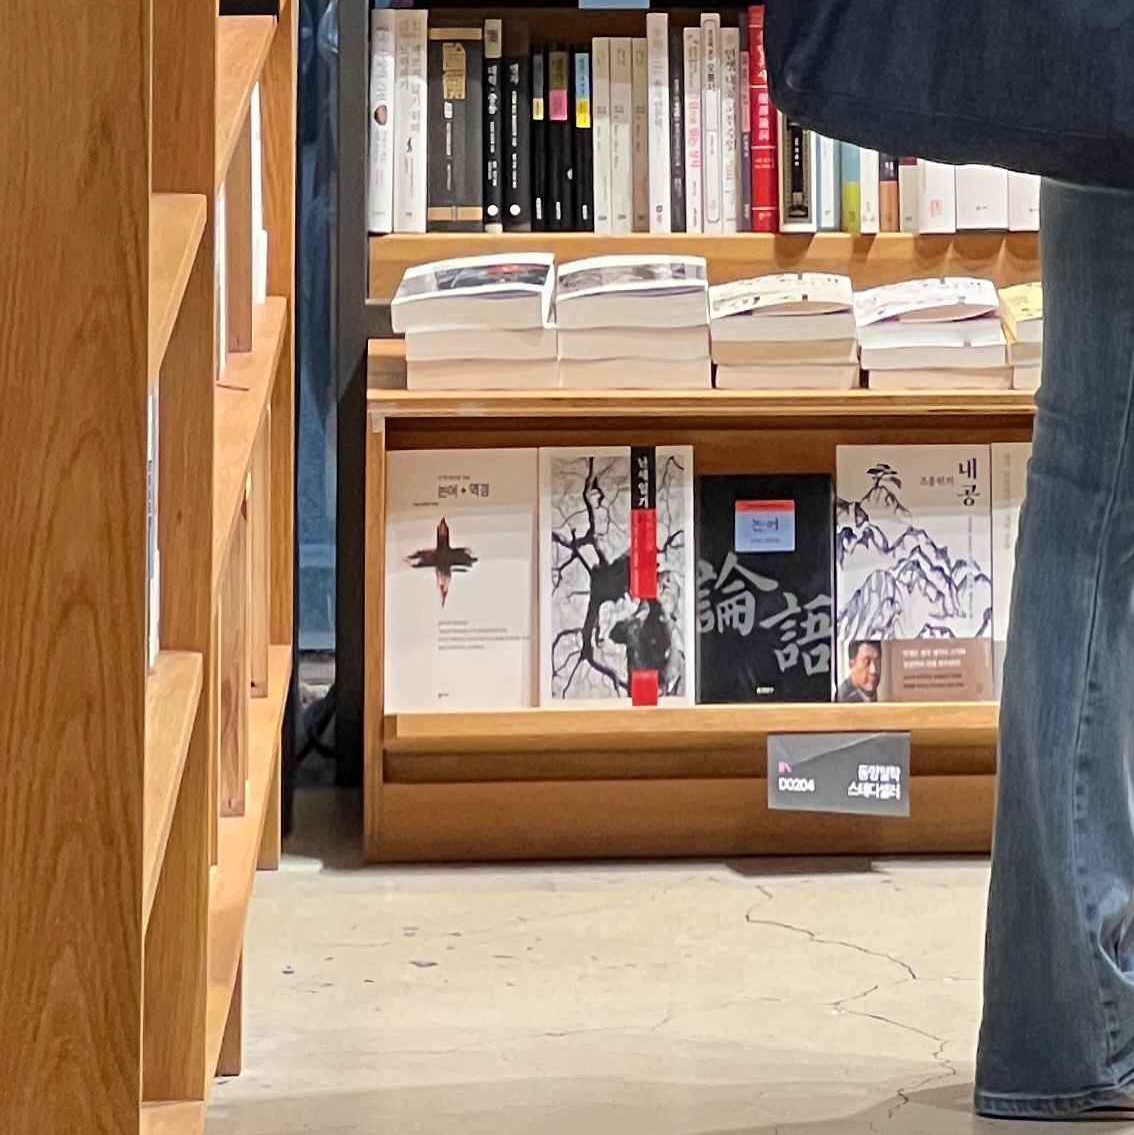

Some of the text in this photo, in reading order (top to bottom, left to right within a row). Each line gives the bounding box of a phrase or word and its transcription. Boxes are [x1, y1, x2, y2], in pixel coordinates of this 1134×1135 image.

[957, 457, 980, 506] 내공
[751, 517, 779, 532] 논어
[697, 552, 832, 675] 論語
[778, 777, 815, 792] D0204
[847, 781, 901, 801] 스테디셀러
